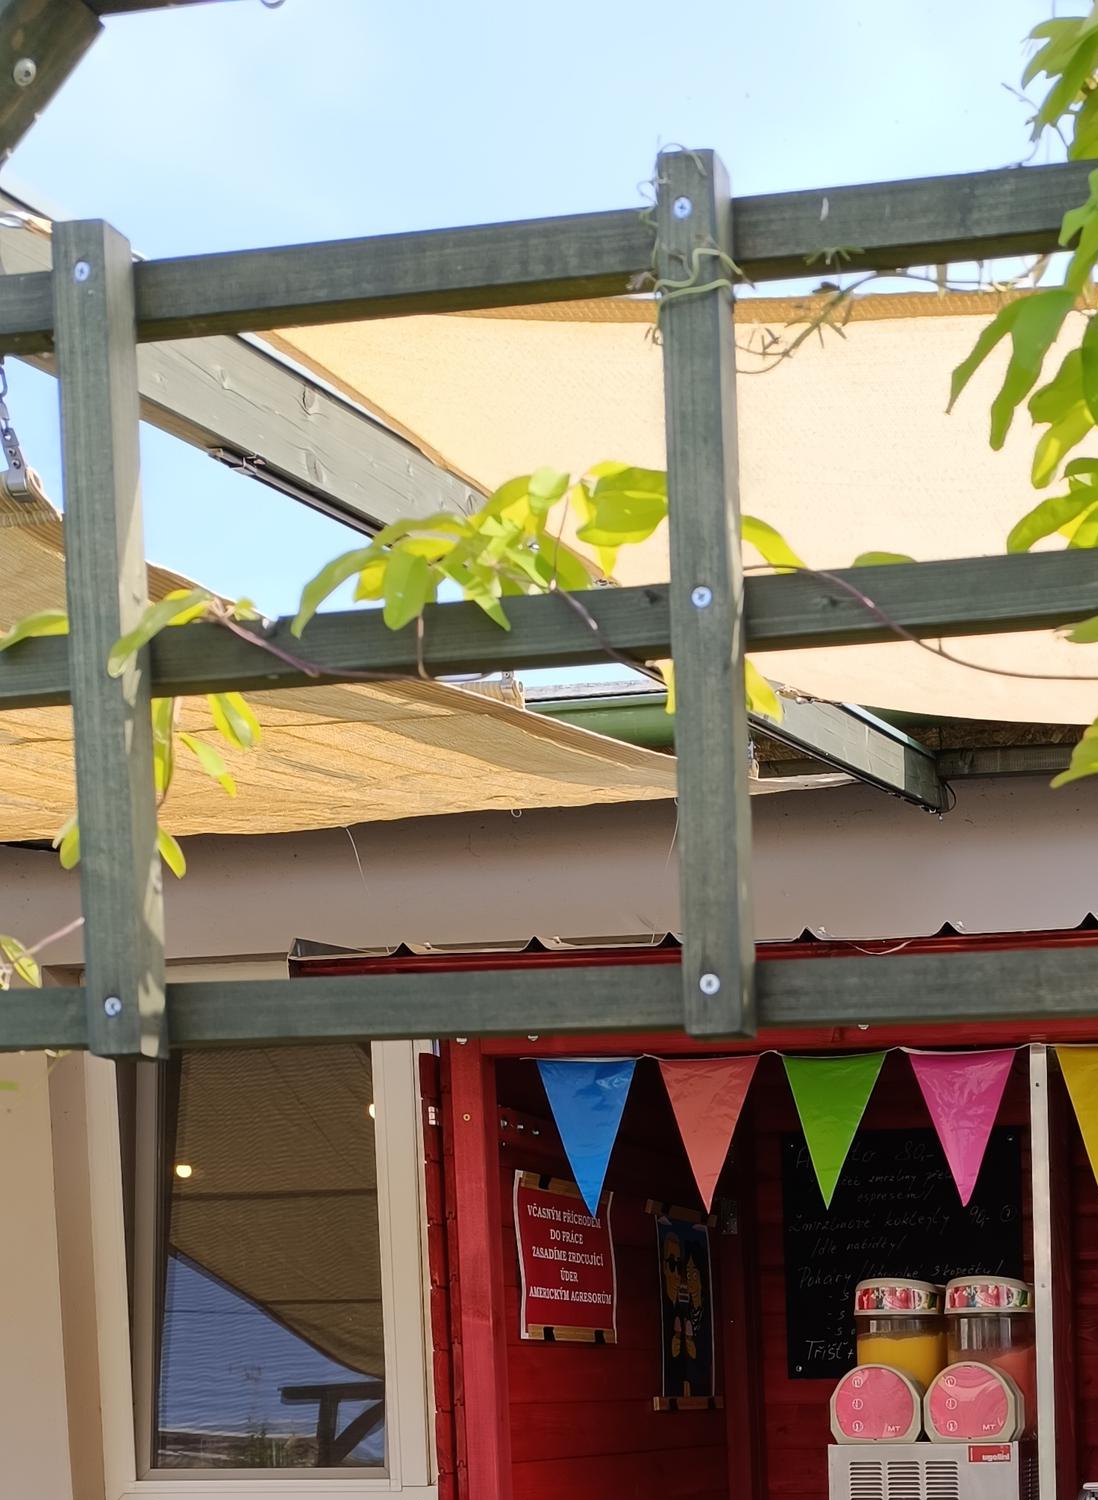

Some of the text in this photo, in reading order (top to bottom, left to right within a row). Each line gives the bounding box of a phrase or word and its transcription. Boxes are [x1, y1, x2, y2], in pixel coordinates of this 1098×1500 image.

[527, 1203, 602, 1228] VČASNÝM PŘÍCHODEM
[550, 1229, 584, 1244] DO PRÁCE
[532, 1246, 568, 1261] ZASADÍME
[560, 1267, 579, 1282] ÚDER
[529, 1286, 570, 1301] AMERICKÝM
[887, 1425, 901, 1433] MT
[982, 1423, 997, 1431] MT
